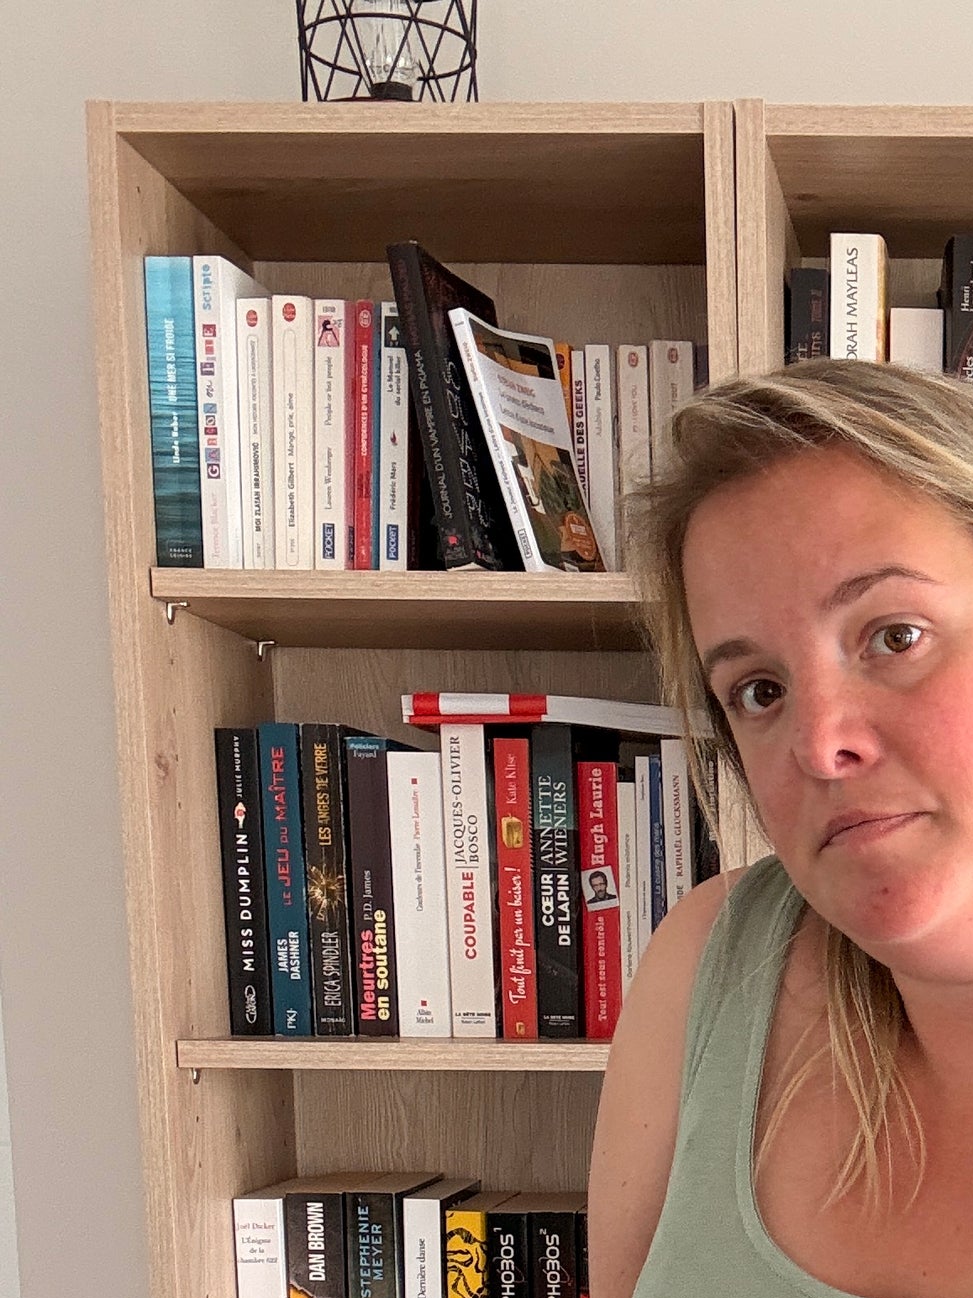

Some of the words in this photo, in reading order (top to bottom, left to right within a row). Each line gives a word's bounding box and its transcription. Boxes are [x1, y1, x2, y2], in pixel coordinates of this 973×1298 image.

[960, 286, 970, 311] Henri
[165, 318, 174, 350] FROIDE
[166, 353, 175, 361] SI
[166, 364, 176, 382] MER
[414, 350, 428, 389] PYJAMA
[167, 385, 177, 402] UNE
[420, 391, 430, 403] EN
[424, 406, 440, 446] VAMPIRE
[432, 448, 444, 470] D'UN
[436, 473, 452, 518] JOURNAL
[323, 524, 333, 558] POCKET
[388, 528, 396, 558] POCKET
[449, 736, 466, 864] JACQUES-OLIVIER
[590, 768, 603, 818] Laurie
[672, 775, 682, 835] GLUCKSMANN
[468, 814, 479, 862] BOSCO
[539, 775, 552, 864] ANNETTE
[554, 782, 567, 864] WIENERS
[591, 823, 606, 865] Hugh
[673, 838, 683, 877] RAPHAËL
[462, 872, 477, 959] COUPABLE
[542, 874, 554, 926] CŒUR
[557, 874, 570, 921] LAPIN
[289, 931, 301, 979] DASHNER
[321, 931, 340, 977] SPINDLER
[373, 910, 389, 990] soutane
[558, 925, 571, 946] DE
[596, 916, 605, 957] contrôle
[278, 939, 288, 972] JAMES
[360, 930, 377, 1020] Meurtres
[598, 959, 606, 981] sous
[324, 979, 342, 1006] ERICA
[377, 996, 390, 1020] en
[598, 983, 607, 997] est
[598, 999, 608, 1021] Tout
[307, 1202, 325, 1250] BROWN
[309, 1254, 325, 1281] DAN
[358, 1206, 370, 1298] STEPHENIE
[372, 1224, 383, 1280] MEYER
[417, 1239, 426, 1263] danse
